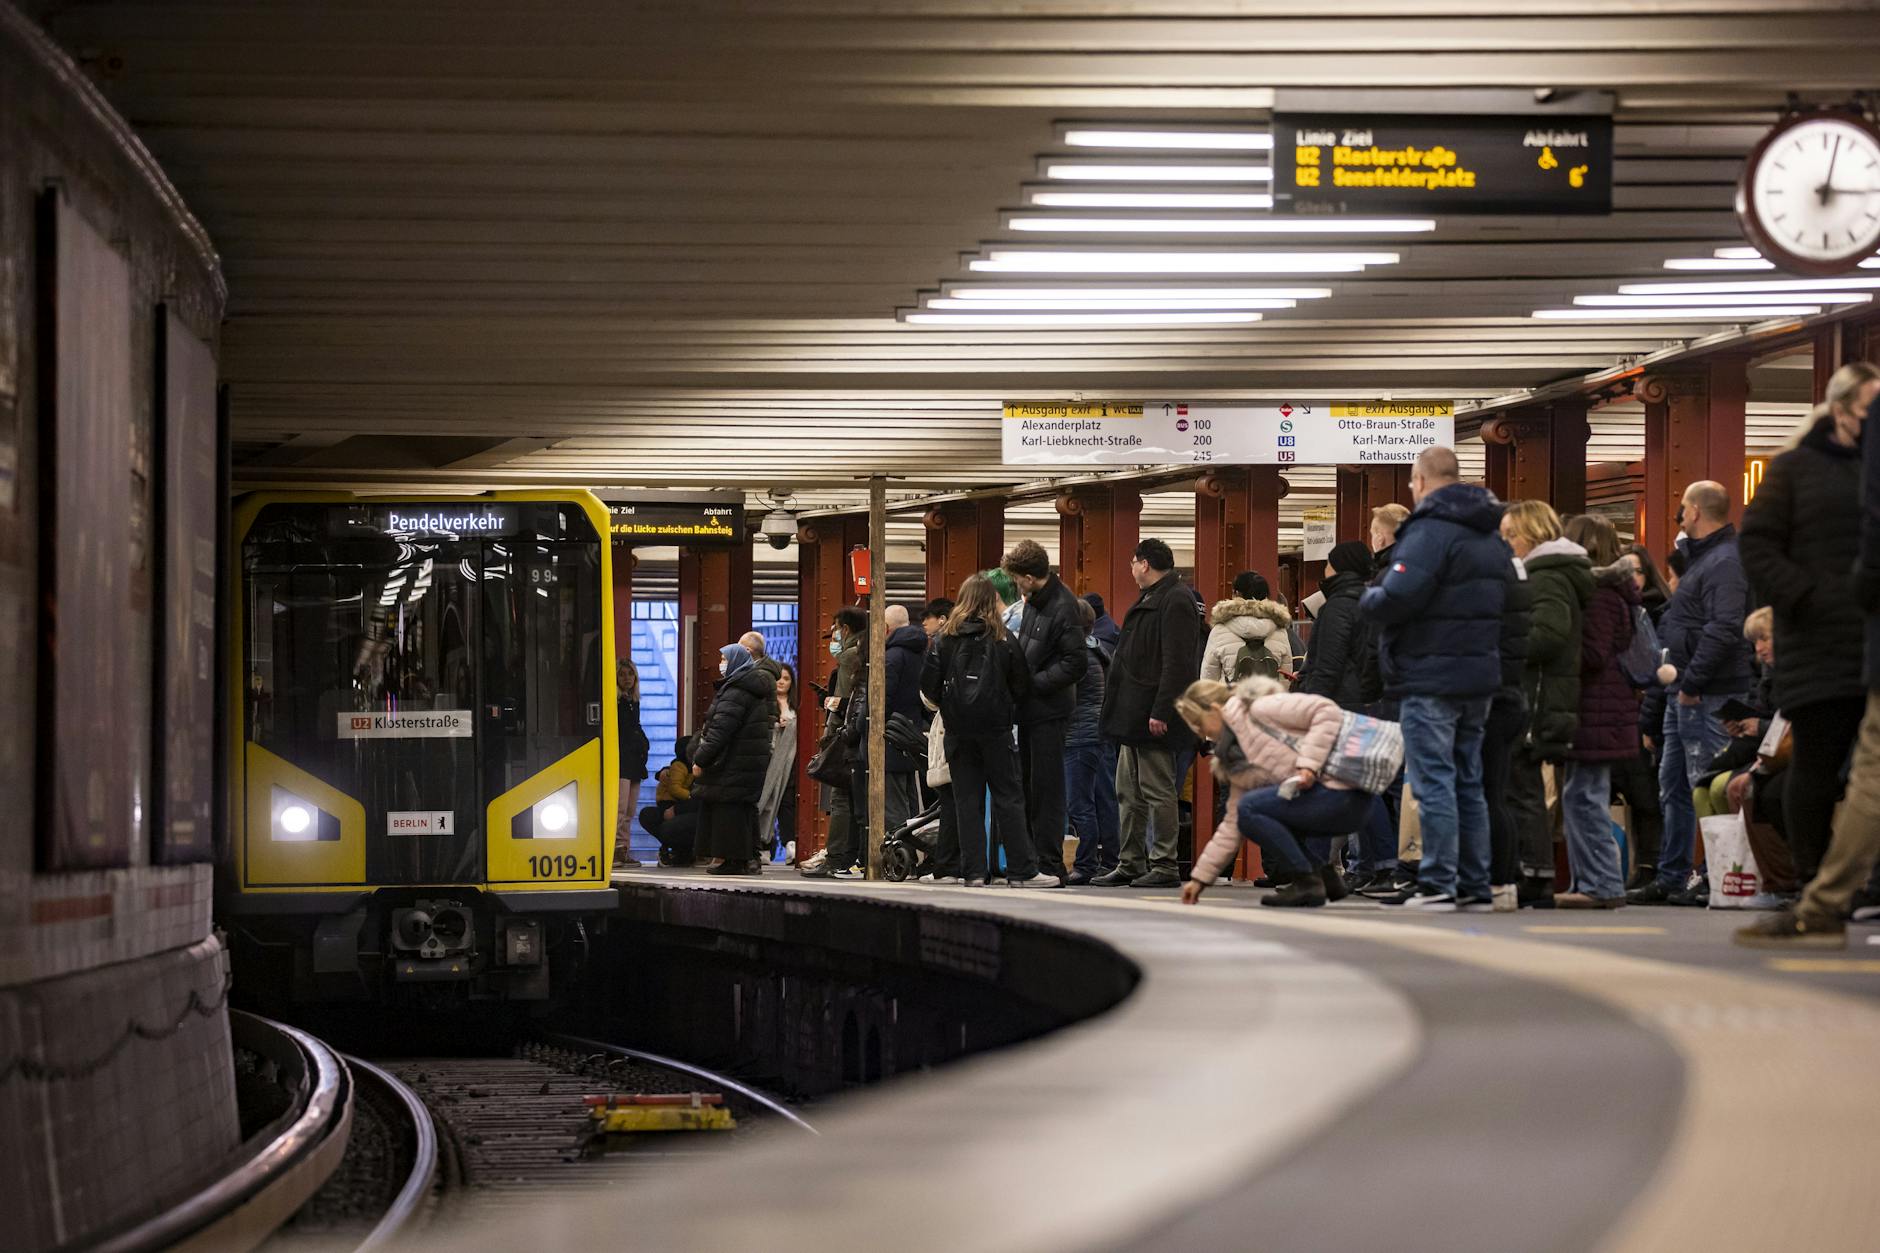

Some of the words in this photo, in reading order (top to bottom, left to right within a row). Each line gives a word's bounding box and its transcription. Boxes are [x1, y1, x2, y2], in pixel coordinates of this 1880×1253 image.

[1341, 130, 1373, 146] Ziel
[1523, 130, 1588, 147] Abfahrt
[1021, 404, 1068, 416] Ausgang
[1072, 404, 1091, 414] exit
[1113, 406, 1128, 414] WC
[1366, 404, 1385, 414] exit
[1389, 404, 1435, 416] Ausgang
[1021, 420, 1102, 432] Alexanderplatz
[1193, 419, 1212, 430] 100
[1338, 418, 1435, 430] Otto-Braun-Straße
[1021, 435, 1142, 446] Karl-Liebknecht-Straße
[1193, 435, 1212, 446] 200
[1279, 436, 1294, 446] U8
[1353, 434, 1435, 445] Karl-Marx-Allee
[1279, 452, 1294, 461] U5
[620, 506, 635, 515] Ziel
[703, 508, 733, 516] Abfahrt
[390, 512, 504, 530] Pendelverkehr
[620, 524, 632, 533] die
[633, 524, 657, 534] Lücke
[694, 525, 733, 536] Bahnsteig
[352, 718, 370, 729] U2
[374, 715, 460, 729] Klosterstraße
[393, 819, 428, 829] BERLIN
[528, 854, 597, 878] 1019-1
